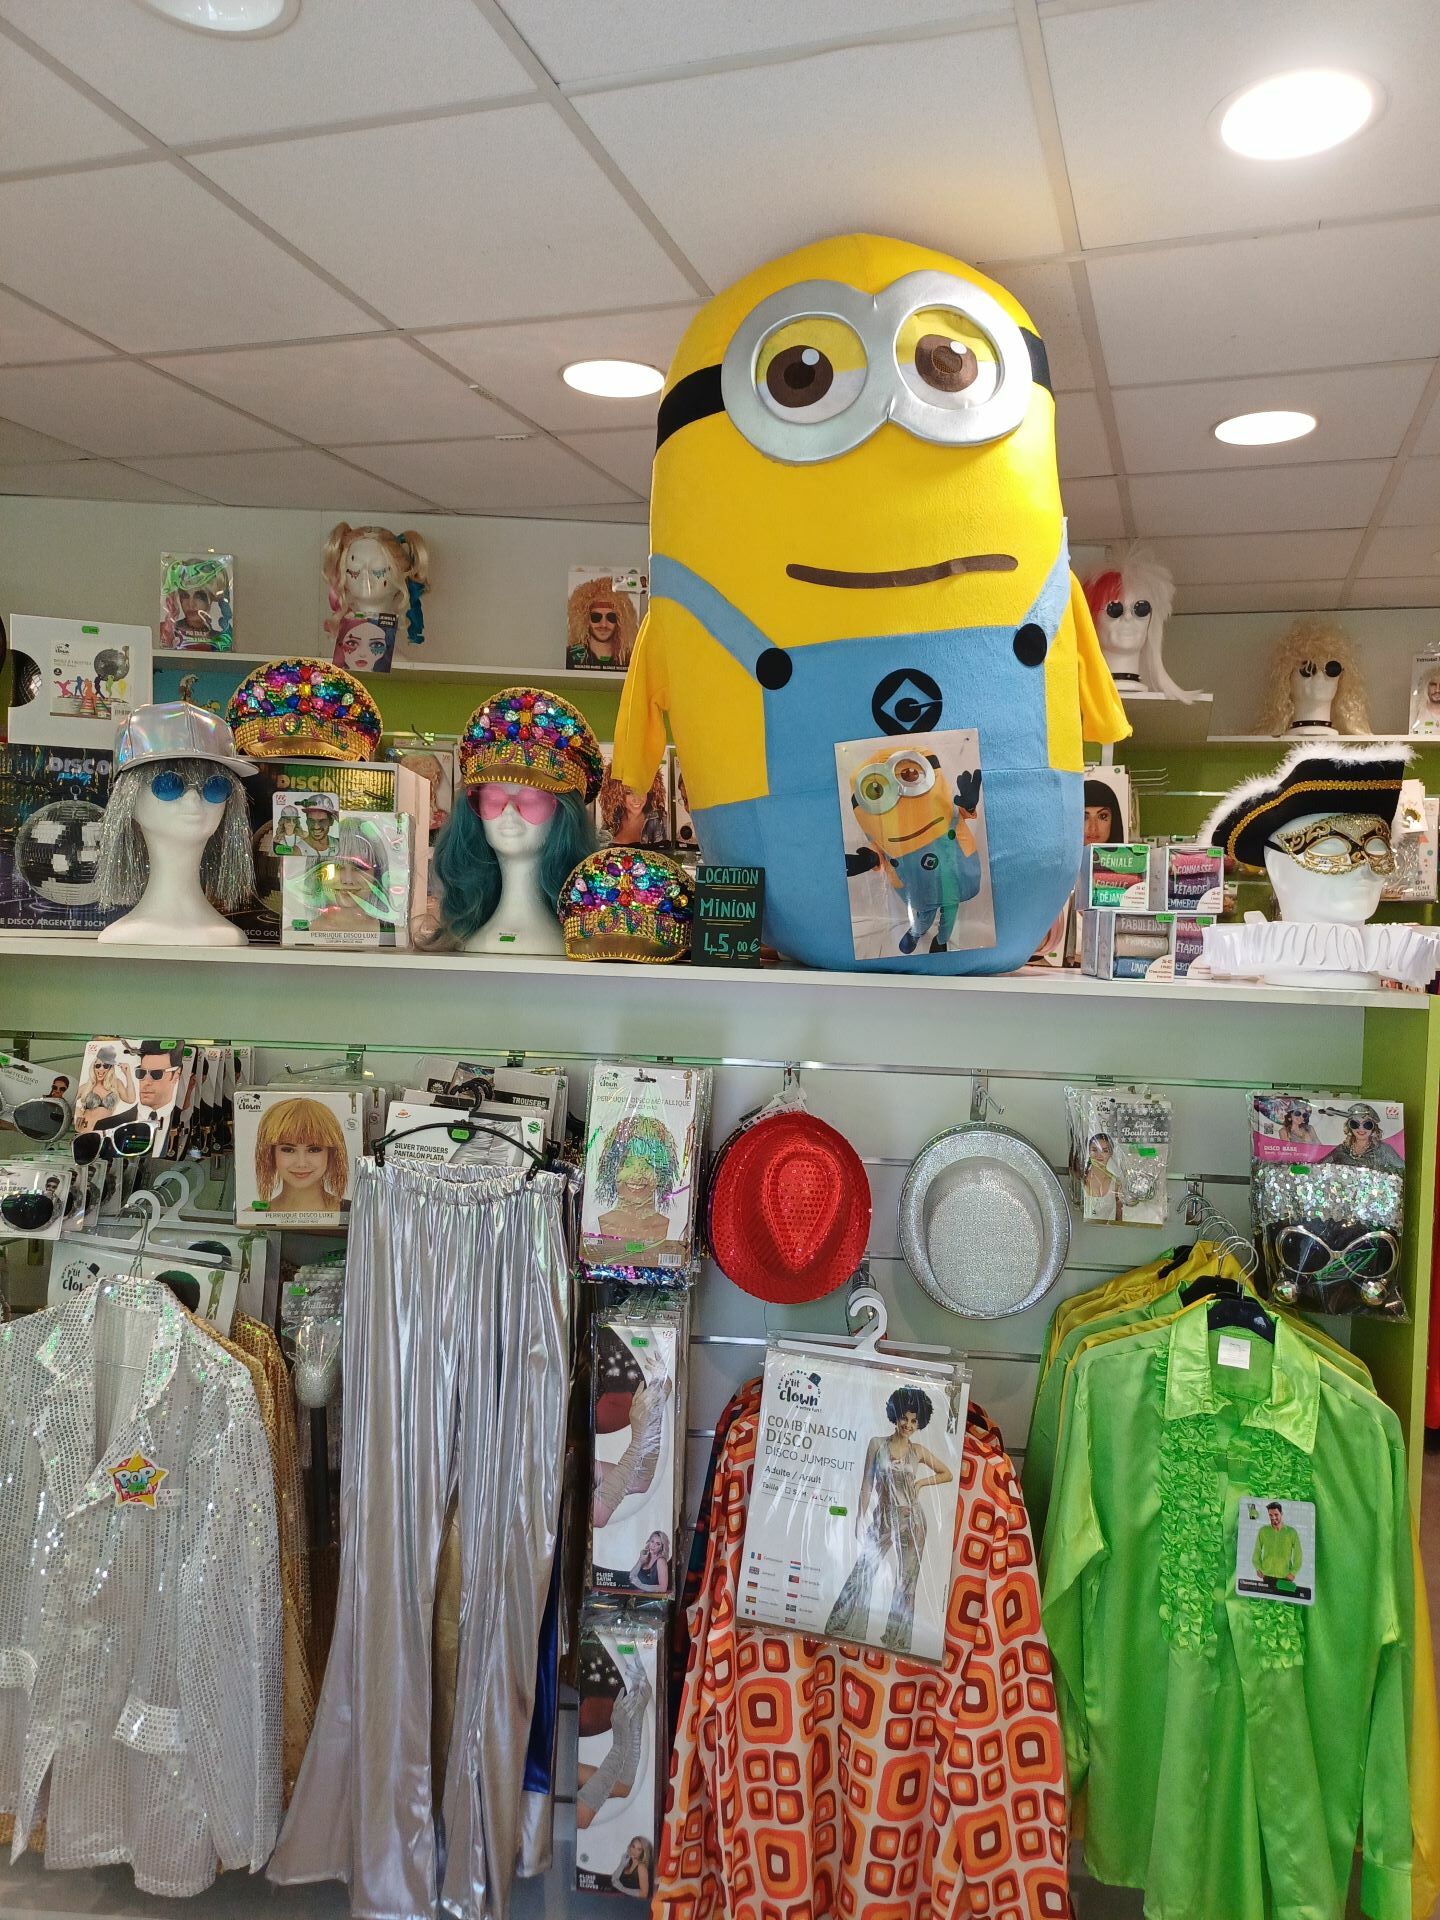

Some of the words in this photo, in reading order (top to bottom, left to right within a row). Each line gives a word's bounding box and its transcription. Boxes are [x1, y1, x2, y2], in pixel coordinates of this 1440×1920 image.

[49, 757, 111, 775] DISCO
[1100, 854, 1133, 868] GÉNIALE
[1177, 863, 1214, 875] CONNASSE
[7, 917, 34, 926] DISCO
[311, 932, 343, 940] PERRUQUE
[512, 1096, 546, 1109] TROUSERS
[1121, 1127, 1147, 1136] Boule
[1148, 1128, 1168, 1136] disco
[394, 1142, 416, 1151] SILVER
[416, 1144, 449, 1155] TROUSERS
[426, 1153, 445, 1161] PLATA
[785, 1379, 800, 1389] p'tit
[779, 1387, 818, 1407] clown
[767, 1415, 857, 1442] COMBINAISON
[766, 1428, 813, 1450] DISCO
[765, 1445, 798, 1461] DISCO
[800, 1453, 855, 1472] JUMPSUIT
[764, 1465, 791, 1478] Adulte
